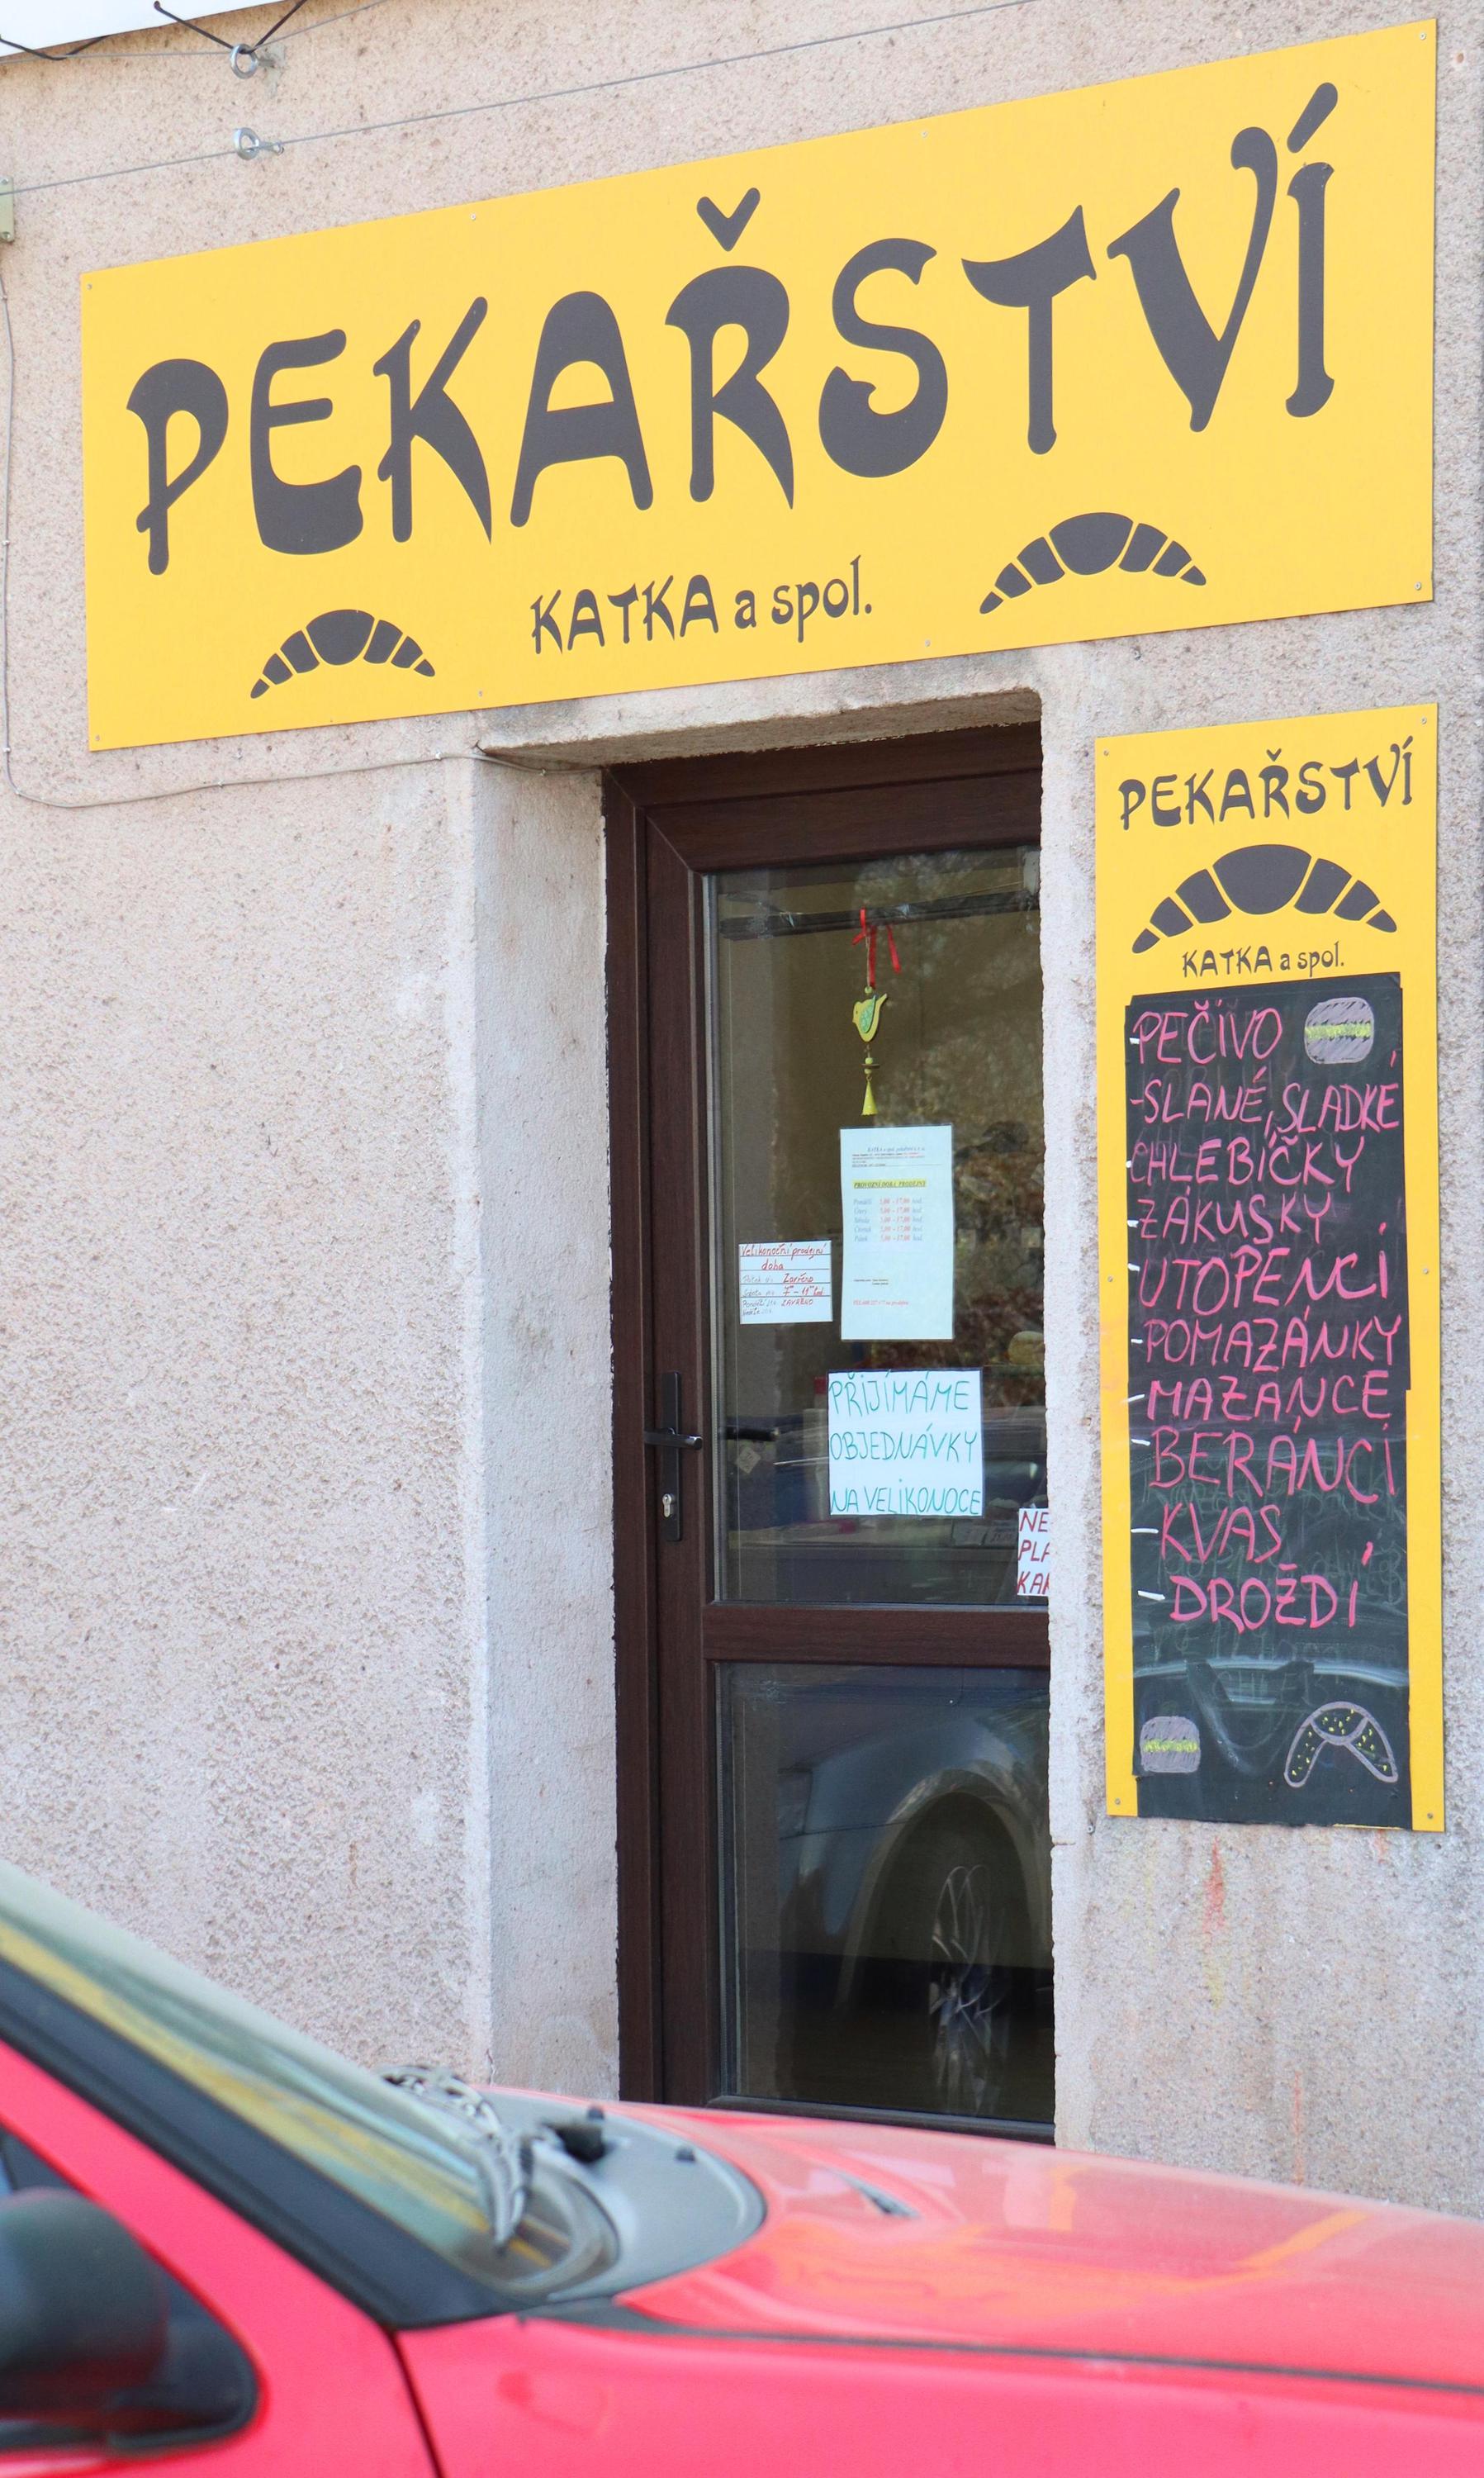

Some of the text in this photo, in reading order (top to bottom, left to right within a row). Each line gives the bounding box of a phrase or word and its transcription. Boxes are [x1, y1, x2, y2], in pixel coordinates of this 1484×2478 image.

[126, 82, 1338, 576] PEKAŘSTVÍ
[530, 555, 872, 655] KATKA a spol.
[1118, 735, 1413, 830] PEKAŘSTVÍ
[1182, 942, 1344, 977] KATKA a spol.
[1134, 999, 1282, 1064] PEČIVO
[1131, 1135, 1364, 1192] CHLEBÍČKY
[1138, 1184, 1331, 1244] ZÁKUSKY
[1144, 1306, 1402, 1373] POMAZÁNKY
[828, 1369, 970, 1417] PŘIJÍMÁME
[1147, 1370, 1392, 1422] MAZANCE
[829, 1422, 978, 1463] OBJEDNÁVKY
[831, 1479, 981, 1515] NA VELIKONOCE
[1161, 1502, 1282, 1564] KVAS
[1169, 1542, 1374, 1634] DROŽDÍ
